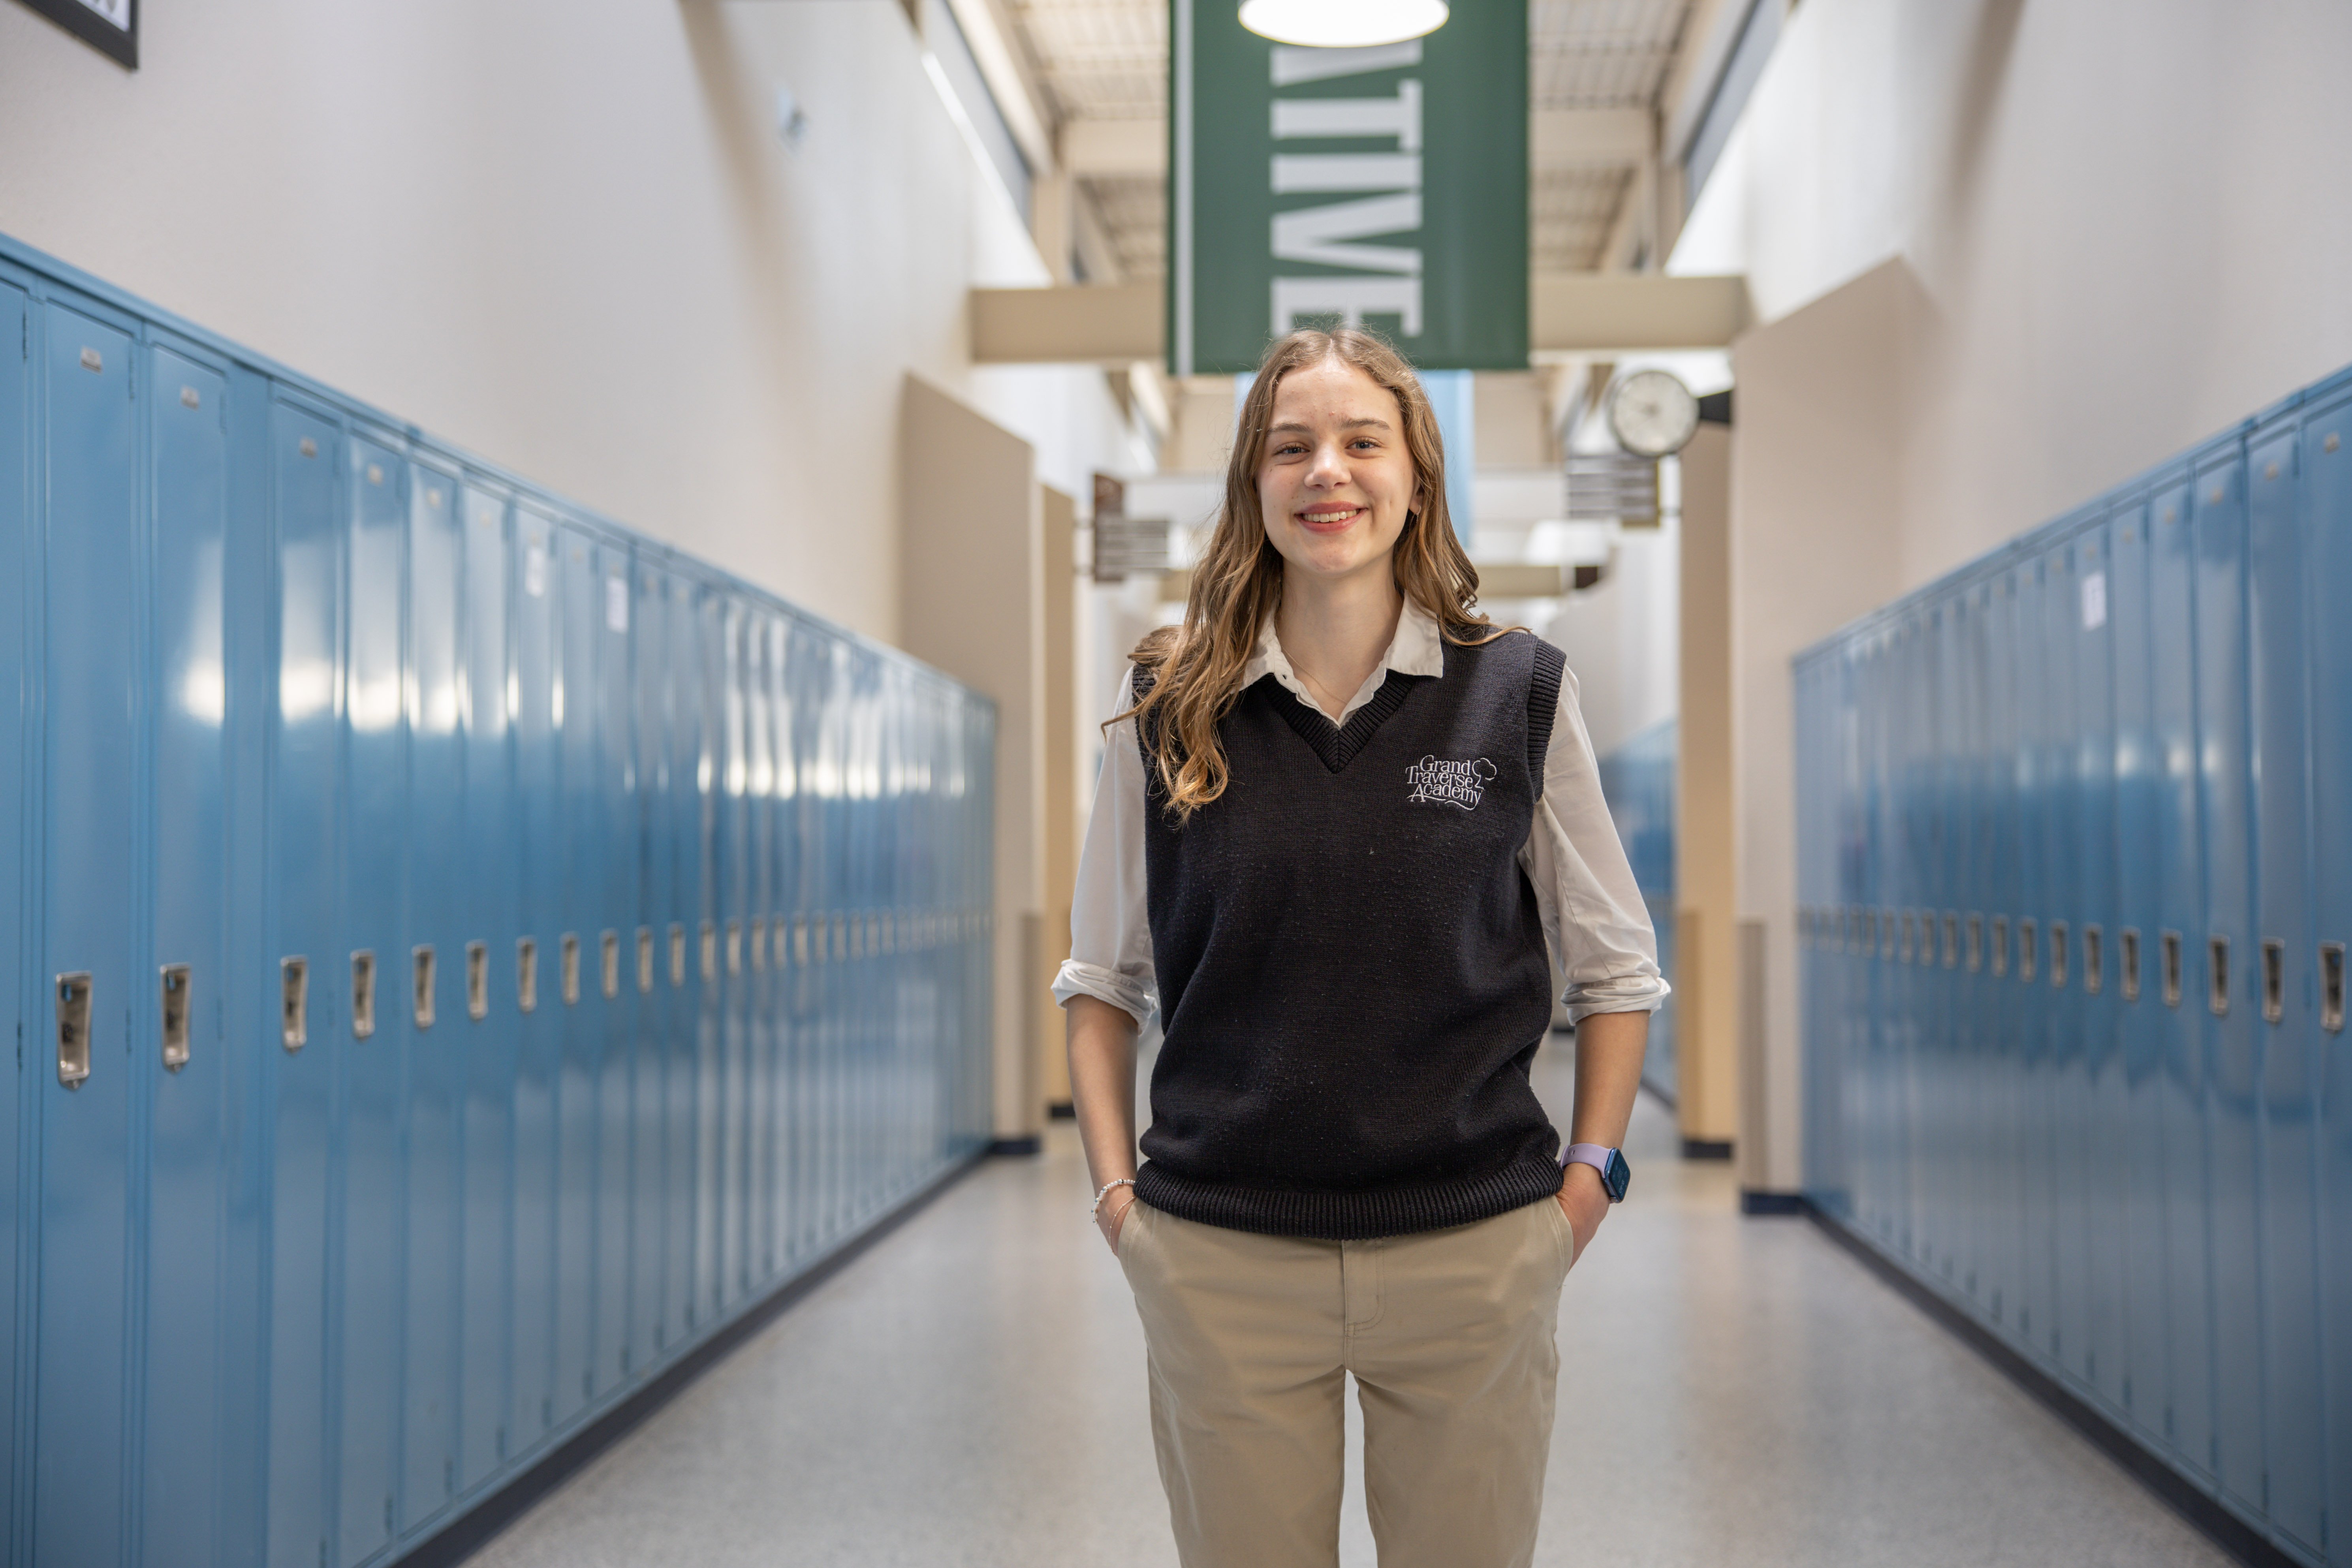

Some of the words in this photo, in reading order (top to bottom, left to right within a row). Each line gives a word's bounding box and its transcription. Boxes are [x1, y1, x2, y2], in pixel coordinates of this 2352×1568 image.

[1420, 755, 1470, 775] Grand
[1405, 765, 1473, 789] Traverse
[1408, 783, 1482, 803] Academy
